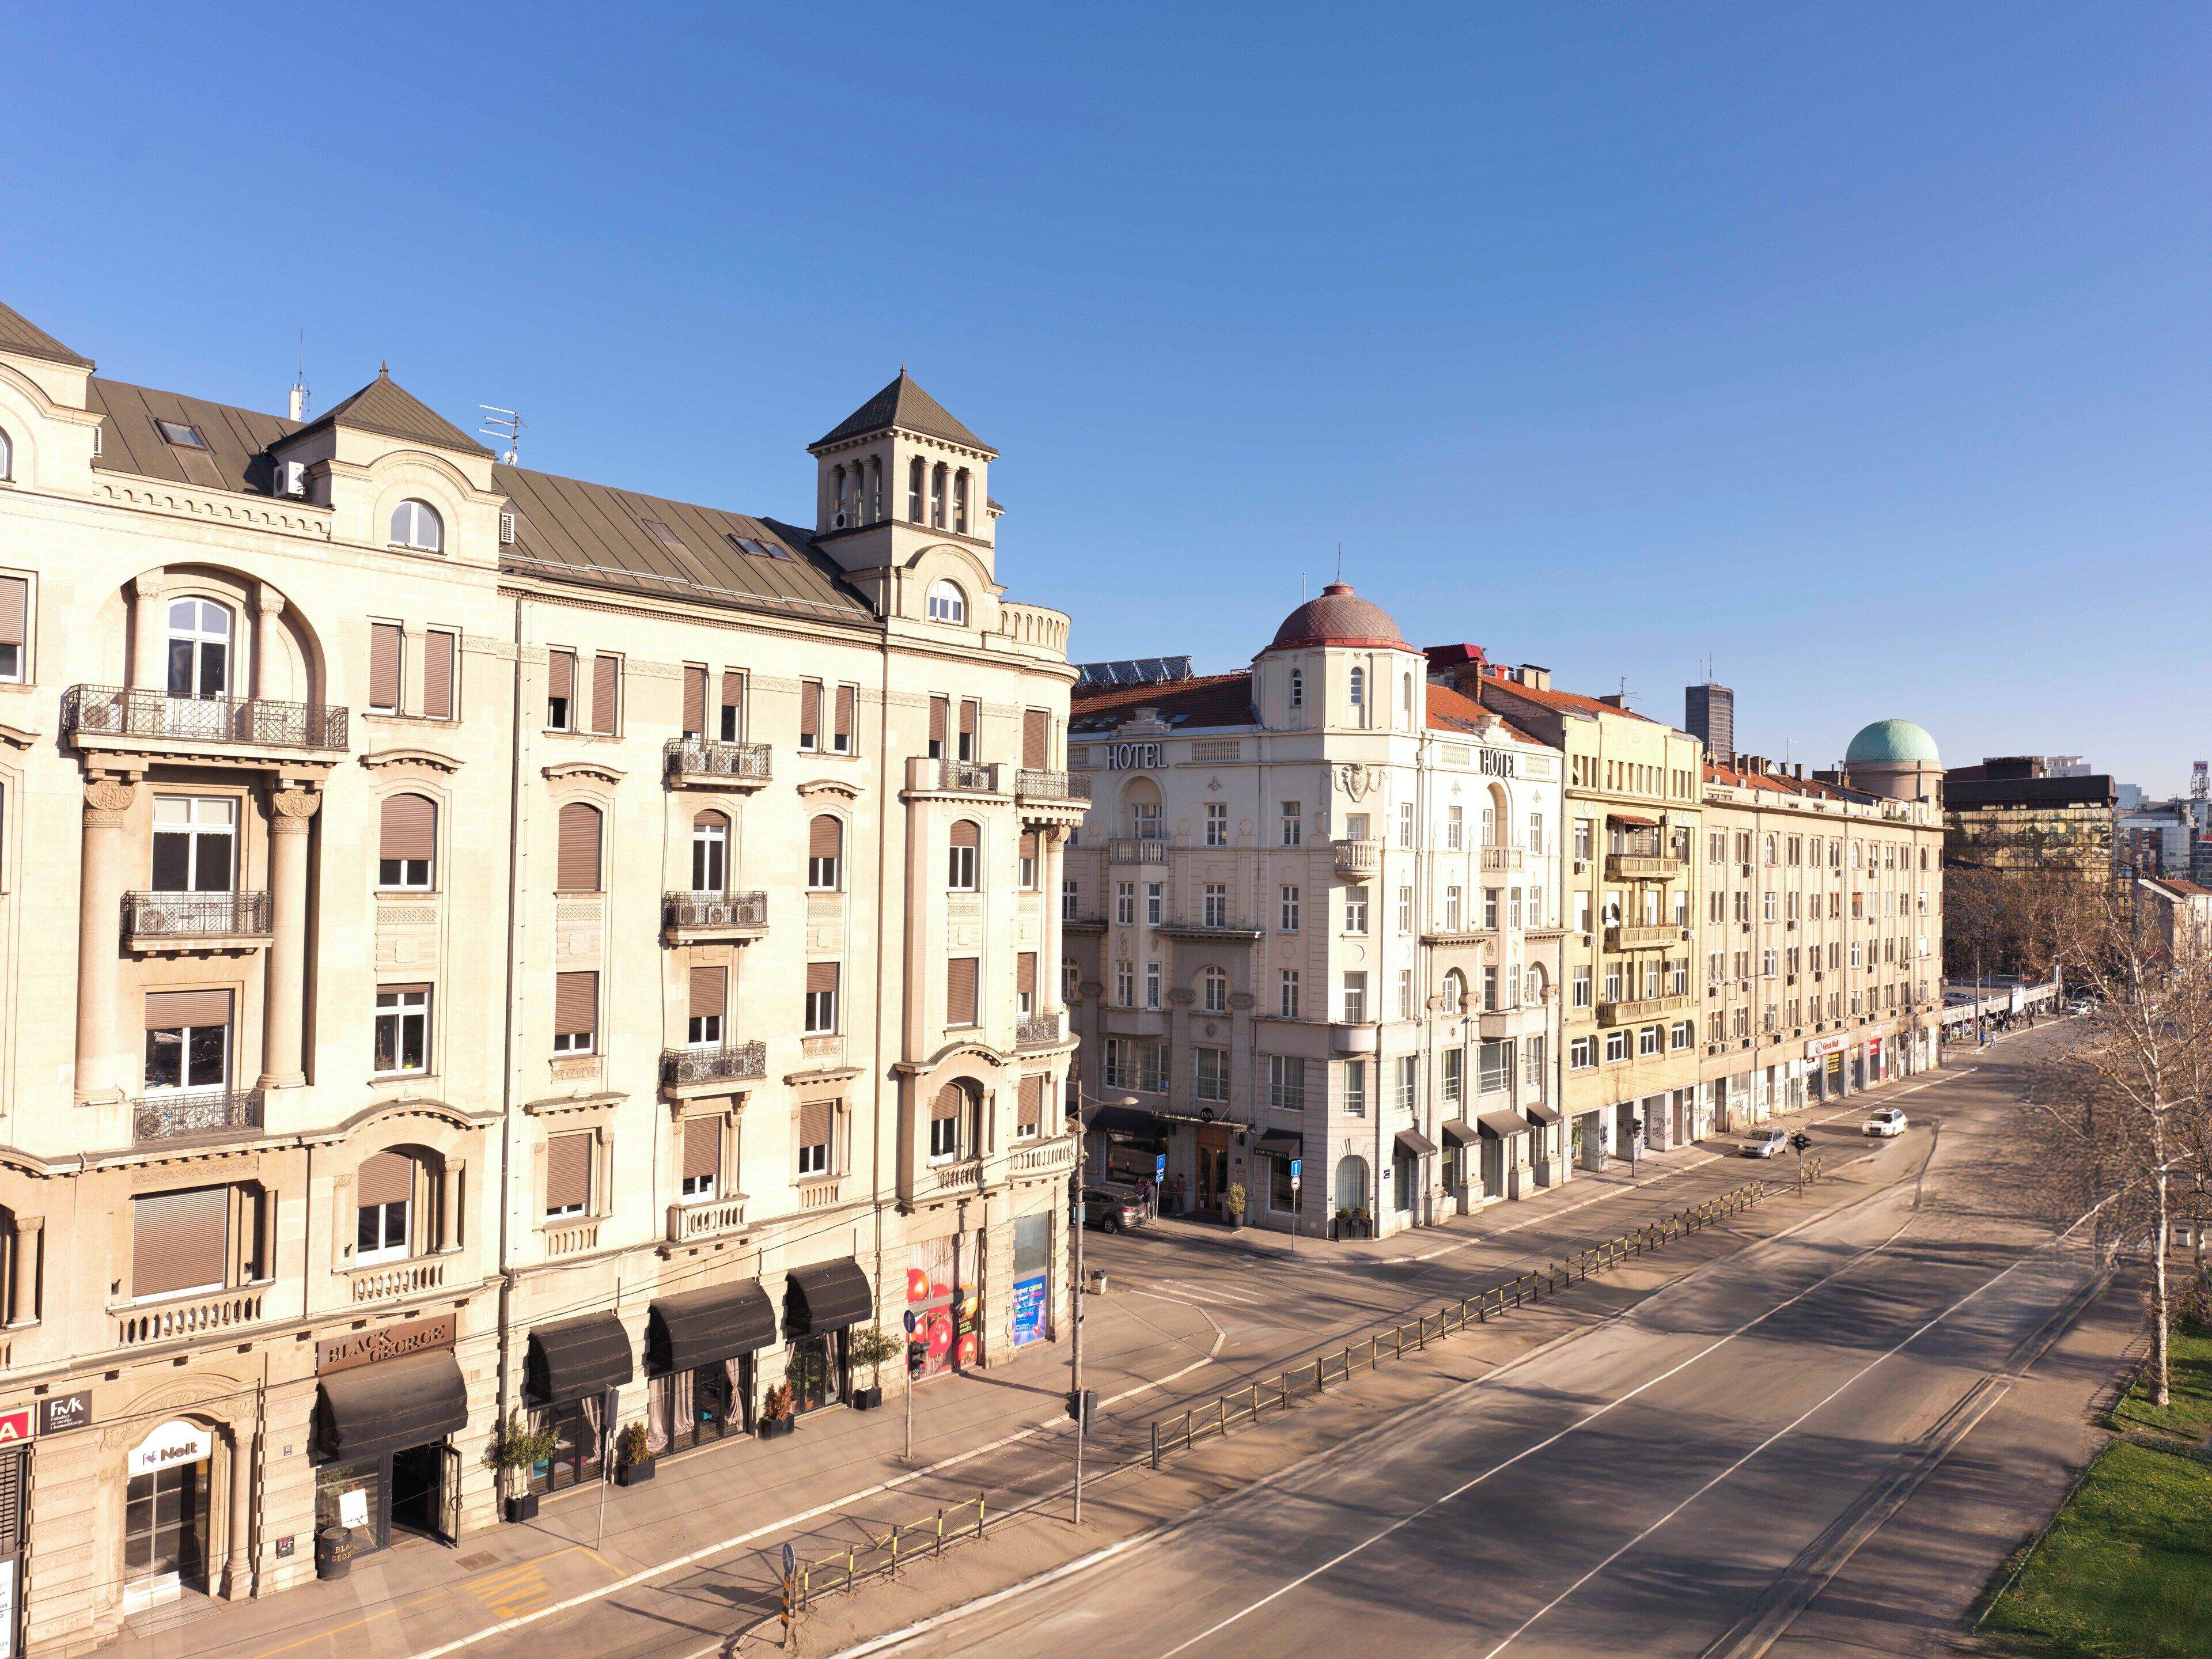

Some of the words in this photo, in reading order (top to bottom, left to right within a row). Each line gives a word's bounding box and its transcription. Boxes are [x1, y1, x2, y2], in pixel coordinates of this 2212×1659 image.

[1105, 743, 1168, 770] HOTEL
[1480, 749, 1517, 778] HOTEL
[1201, 1111, 1213, 1119] INN
[1159, 1157, 1163, 1168] P
[1014, 1286, 1029, 1296] Super
[1029, 1282, 1043, 1292] cena
[328, 1328, 392, 1364] BLACK
[369, 1324, 445, 1363] GEORGE
[51, 1397, 84, 1417] FMK
[54, 1419, 84, 1430] komunikacije
[57, 1418, 72, 1426] medije
